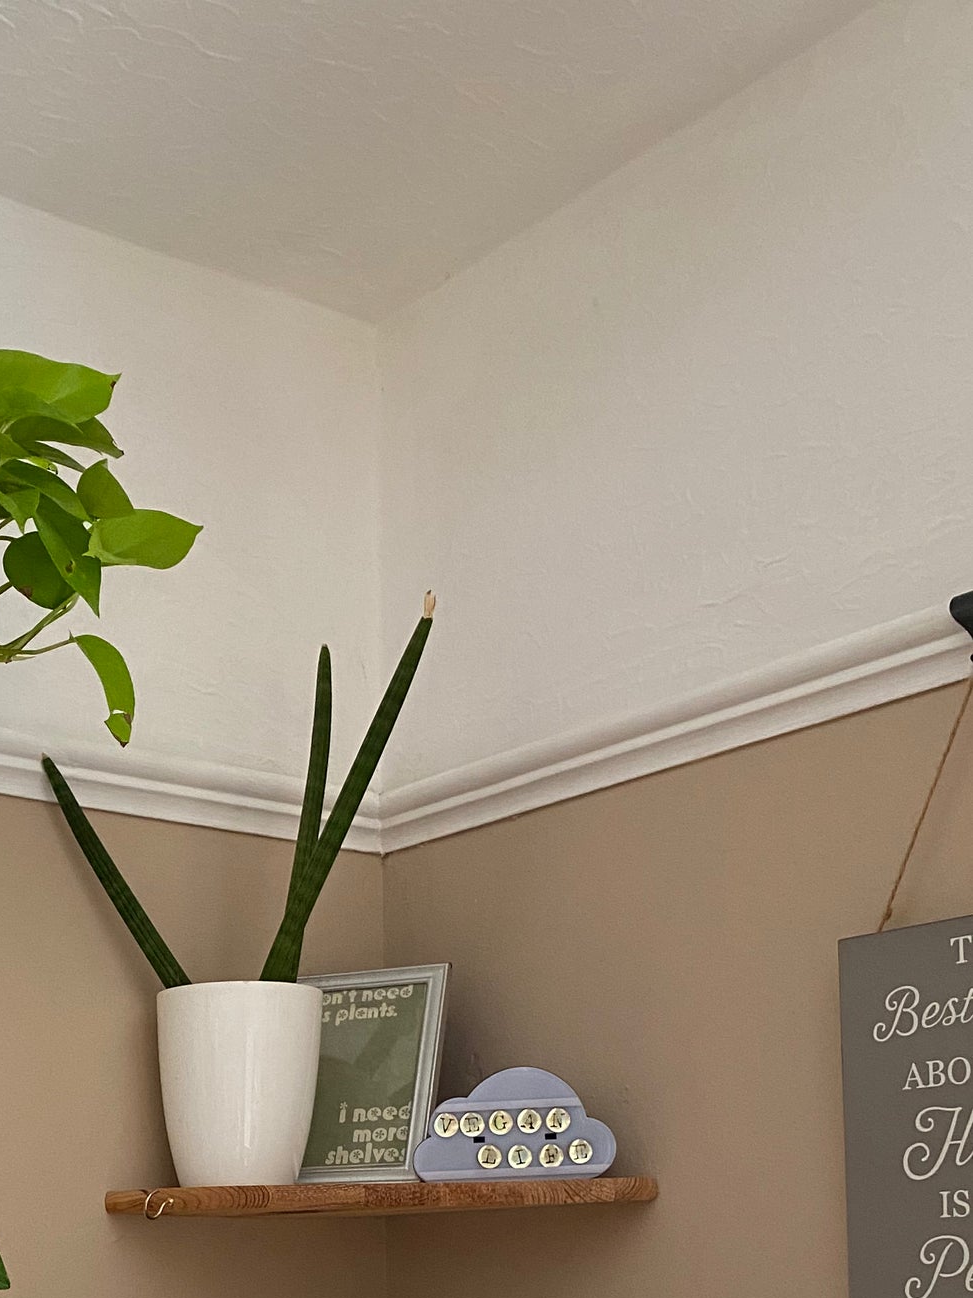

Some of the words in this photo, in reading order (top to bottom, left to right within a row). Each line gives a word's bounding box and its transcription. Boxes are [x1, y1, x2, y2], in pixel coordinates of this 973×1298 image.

[361, 984, 414, 1002] need
[334, 1002, 398, 1026] plants.
[873, 985, 973, 1042] Best
[902, 1056, 972, 1091] ABO
[338, 1101, 348, 1124] i
[352, 1101, 412, 1123] need
[438, 1110, 567, 1135] VEGAN
[352, 1125, 409, 1143] more
[480, 1142, 589, 1166] LIFE
[938, 1189, 971, 1219] IS
